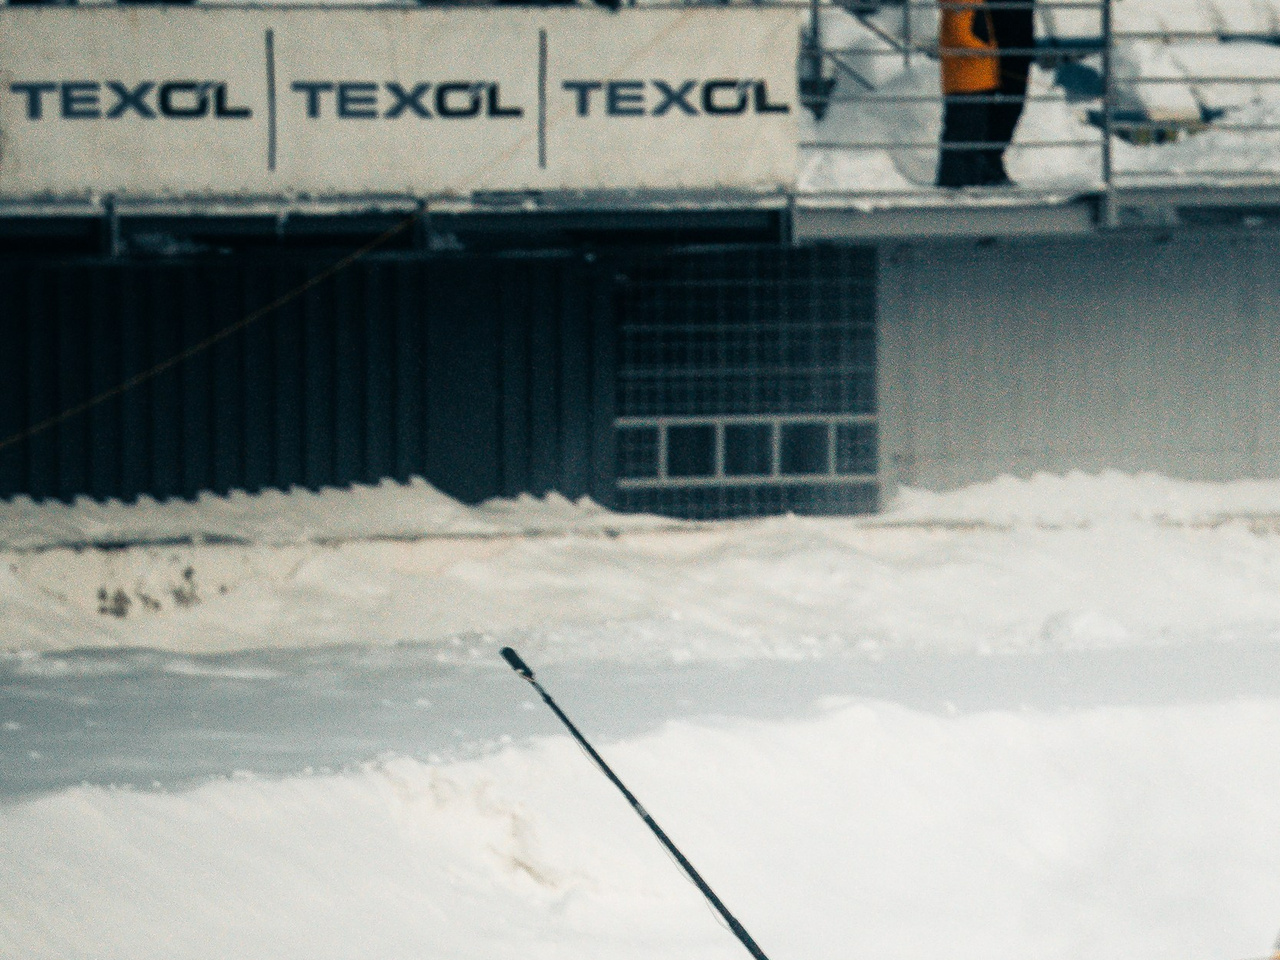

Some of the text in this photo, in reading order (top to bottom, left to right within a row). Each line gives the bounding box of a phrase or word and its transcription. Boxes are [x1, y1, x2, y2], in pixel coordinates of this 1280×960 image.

[10, 81, 253, 120] TEXOL
[291, 80, 523, 119] TEXOL
[562, 79, 790, 117] TEXOL
